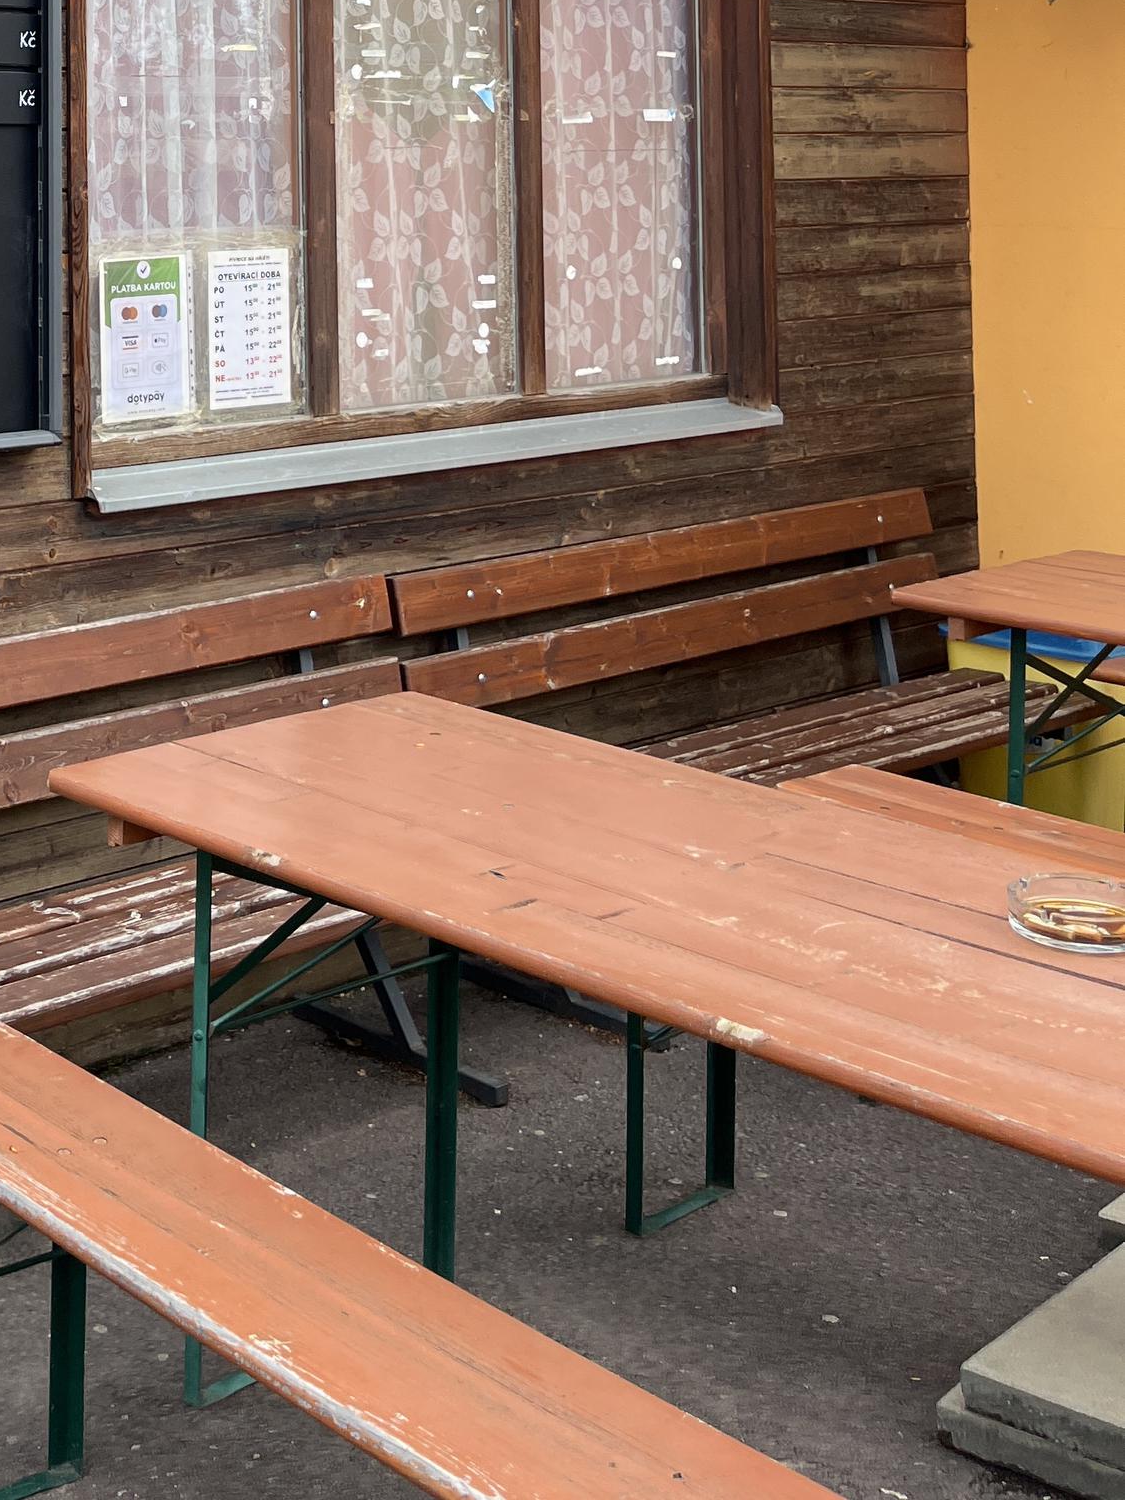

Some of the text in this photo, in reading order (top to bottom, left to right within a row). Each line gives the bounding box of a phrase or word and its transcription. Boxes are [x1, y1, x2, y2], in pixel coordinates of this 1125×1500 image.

[19, 31, 37, 49] Kč
[18, 89, 36, 107] Kč
[260, 270, 281, 279] DOBA
[110, 280, 177, 294] PLATBA KARTOU
[213, 286, 225, 294] PO
[214, 359, 226, 368] SO
[126, 390, 165, 404] dotypay
